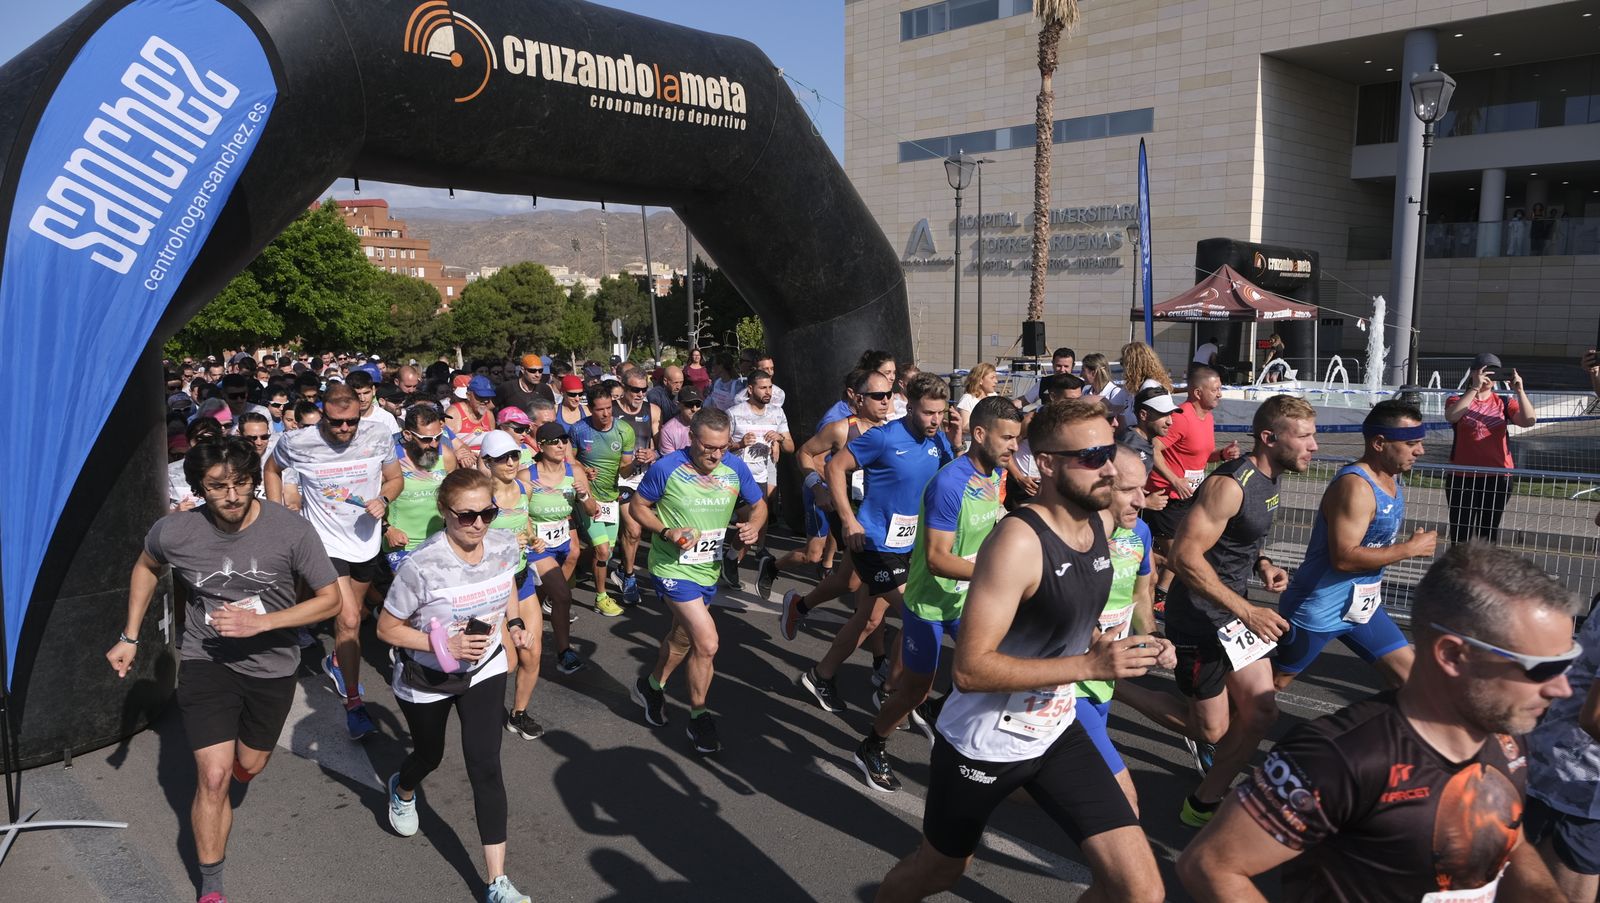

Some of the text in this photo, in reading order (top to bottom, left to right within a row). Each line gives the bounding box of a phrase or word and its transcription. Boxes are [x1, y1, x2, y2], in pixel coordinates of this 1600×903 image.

[503, 35, 746, 114] cruzandolameta
[590, 95, 746, 131] cronometraje deportivo
[144, 102, 268, 291] centrohogarsanchez.es
[695, 496, 731, 506] SAKATA
[546, 526, 564, 540] 121
[896, 525, 916, 538] 220
[693, 540, 717, 553] 122
[1361, 596, 1376, 612] 21
[1024, 695, 1073, 718] 1254
